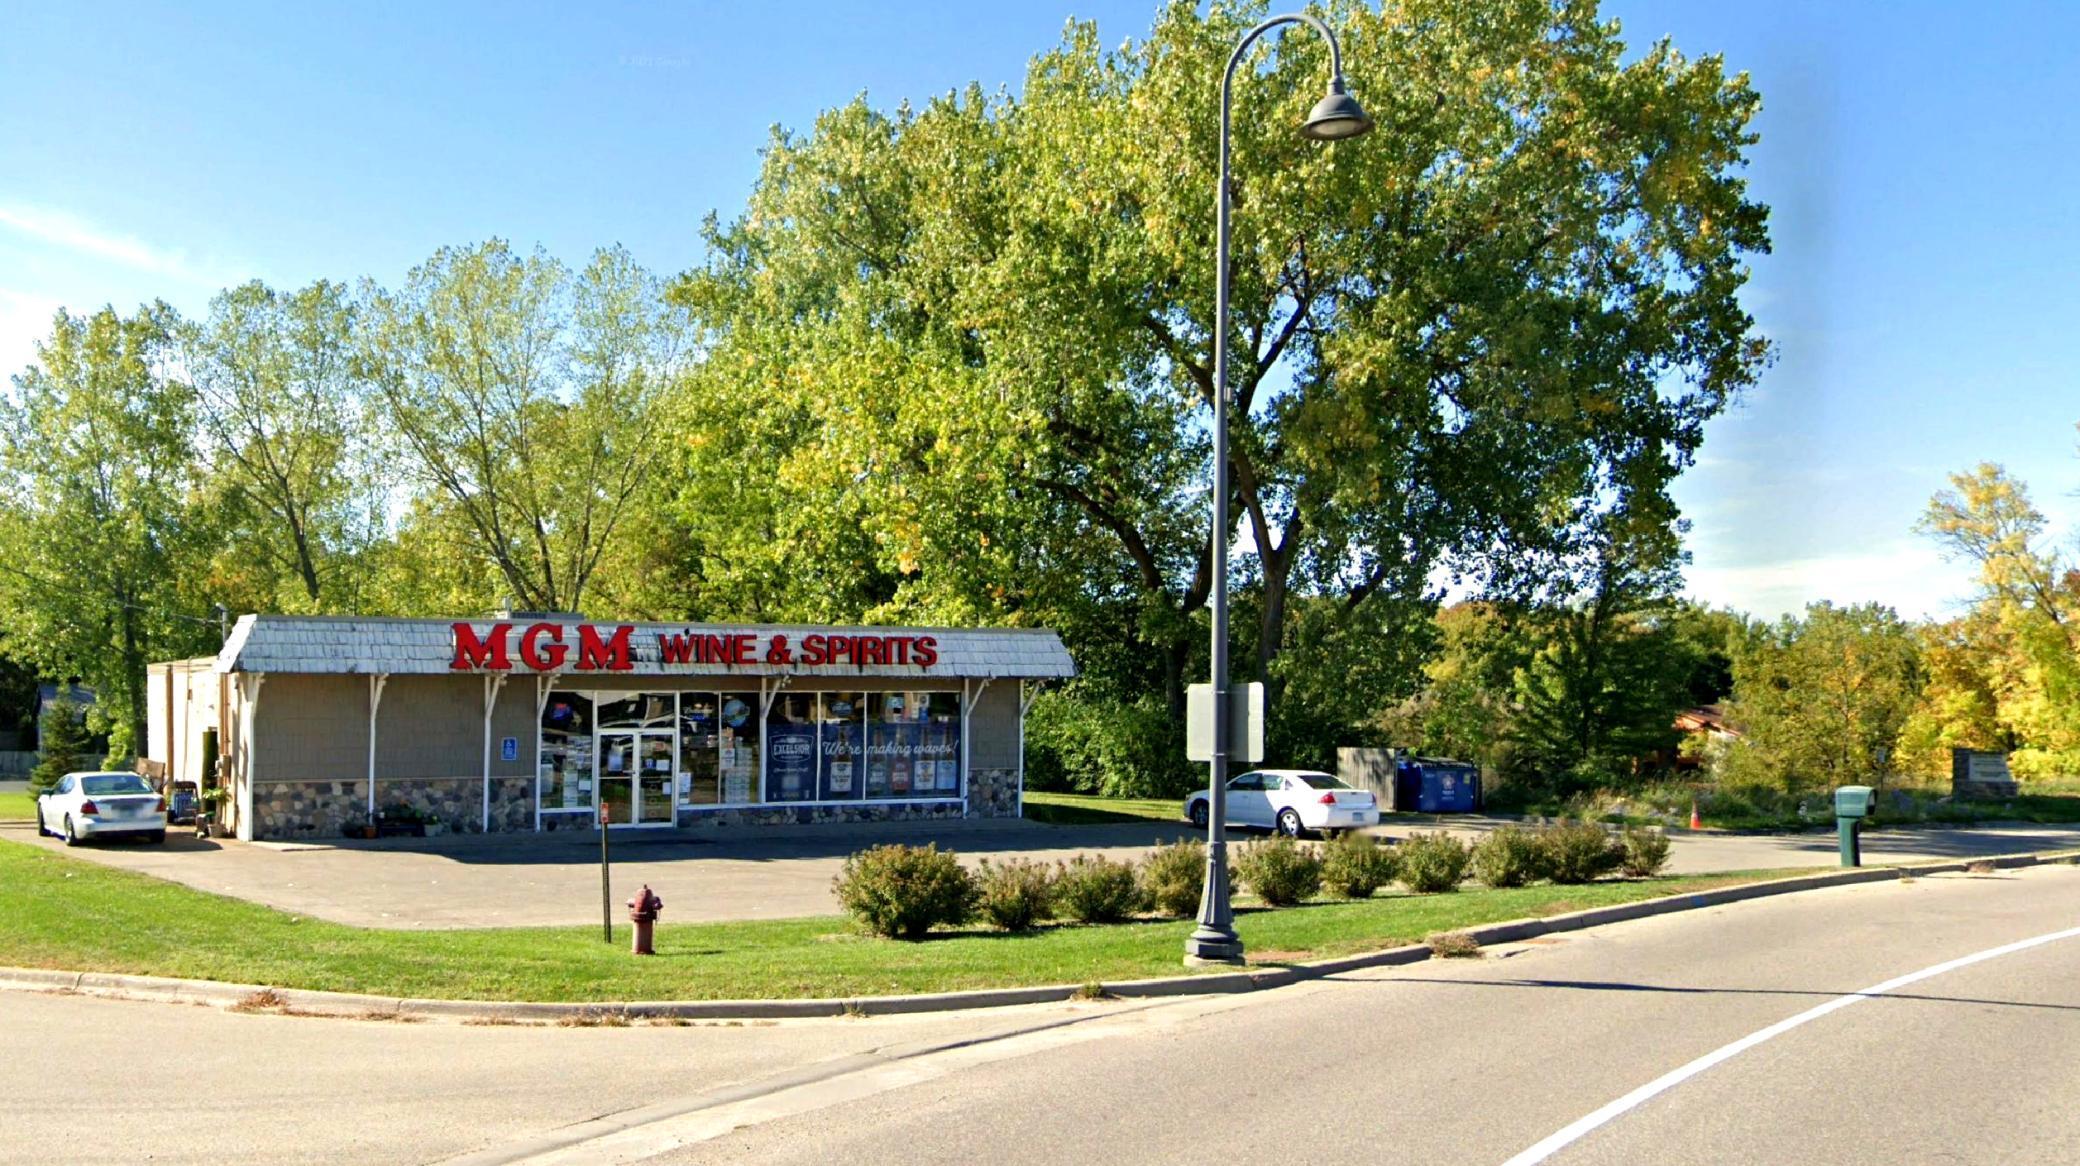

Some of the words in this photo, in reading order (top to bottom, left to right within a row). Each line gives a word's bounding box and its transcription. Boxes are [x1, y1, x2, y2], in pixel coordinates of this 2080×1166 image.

[450, 623, 636, 671] MGM
[659, 634, 757, 665] WINE
[767, 635, 795, 665] &
[801, 634, 938, 667] SPIRITS
[773, 744, 810, 755] EXCELSIOR
[822, 741, 862, 755] We're
[866, 741, 912, 757] making
[913, 740, 959, 754] waves!
